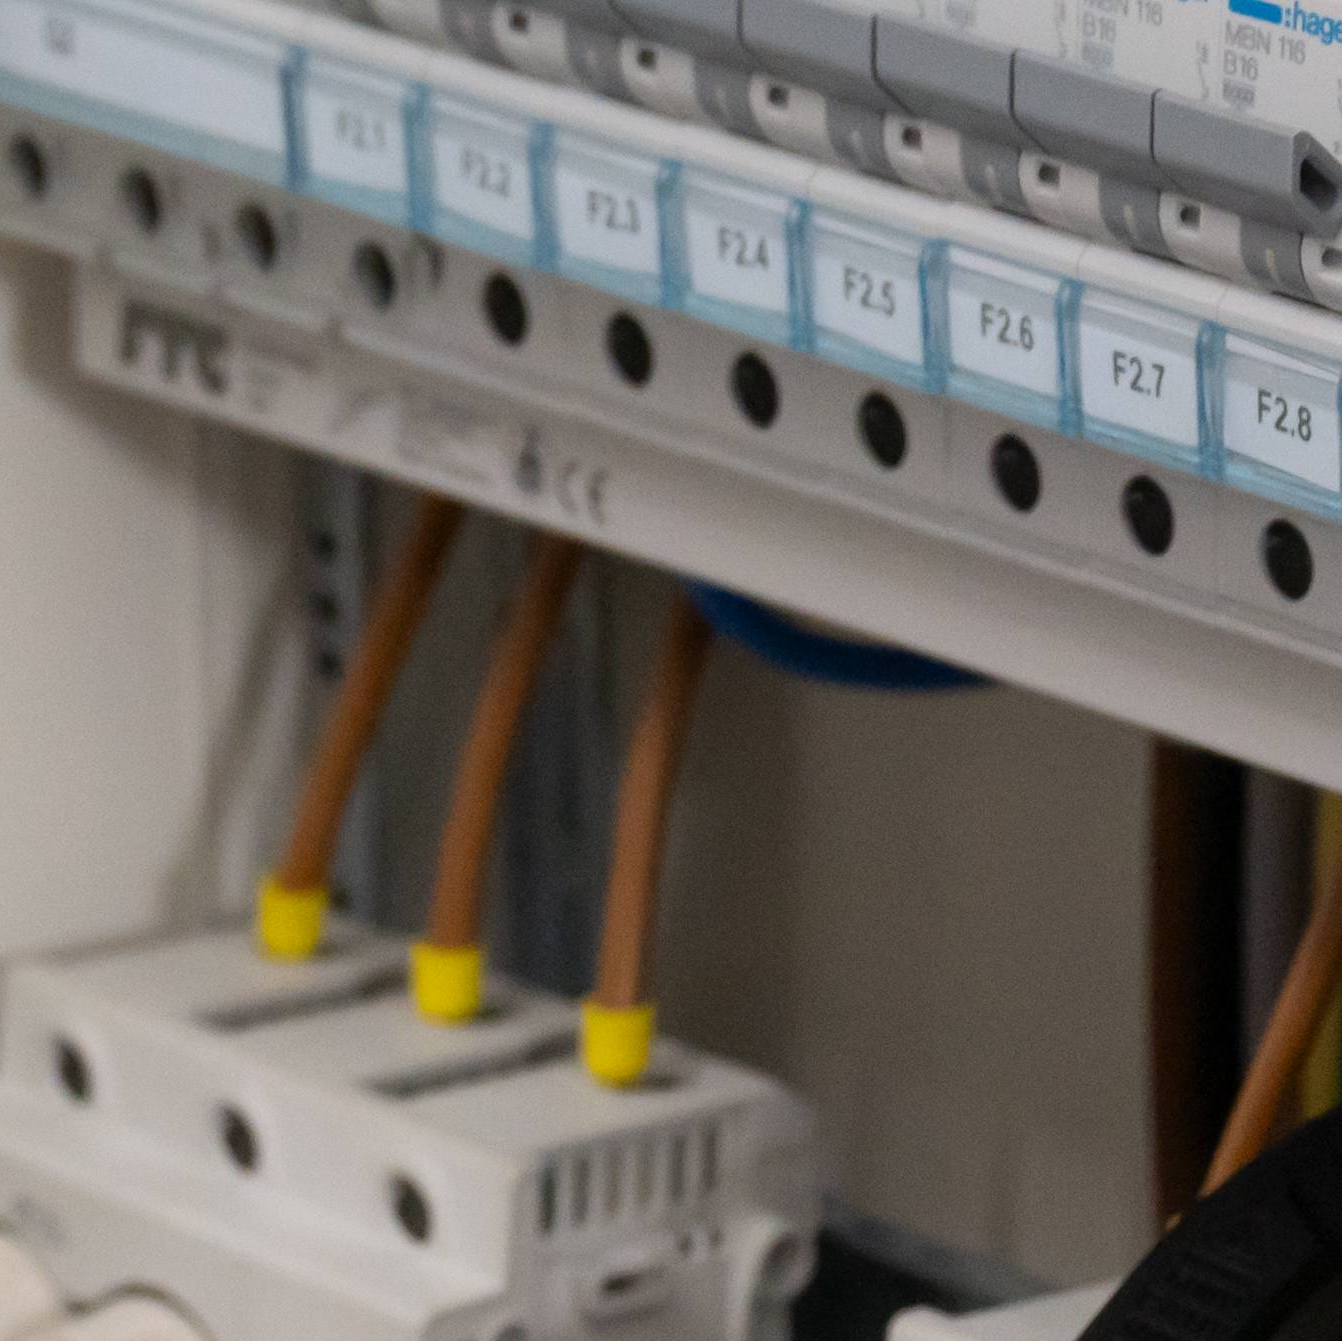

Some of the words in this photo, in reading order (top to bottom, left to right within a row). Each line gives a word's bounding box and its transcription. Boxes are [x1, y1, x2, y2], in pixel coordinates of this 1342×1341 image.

[1225, 21, 1271, 55] MBN
[1278, 35, 1307, 65] 116
[717, 225, 770, 269] F2.4
[842, 264, 897, 317] F2.5
[979, 301, 1035, 353] F2.6
[1112, 351, 1166, 399] F2.7
[1257, 388, 1313, 443] F2.8
